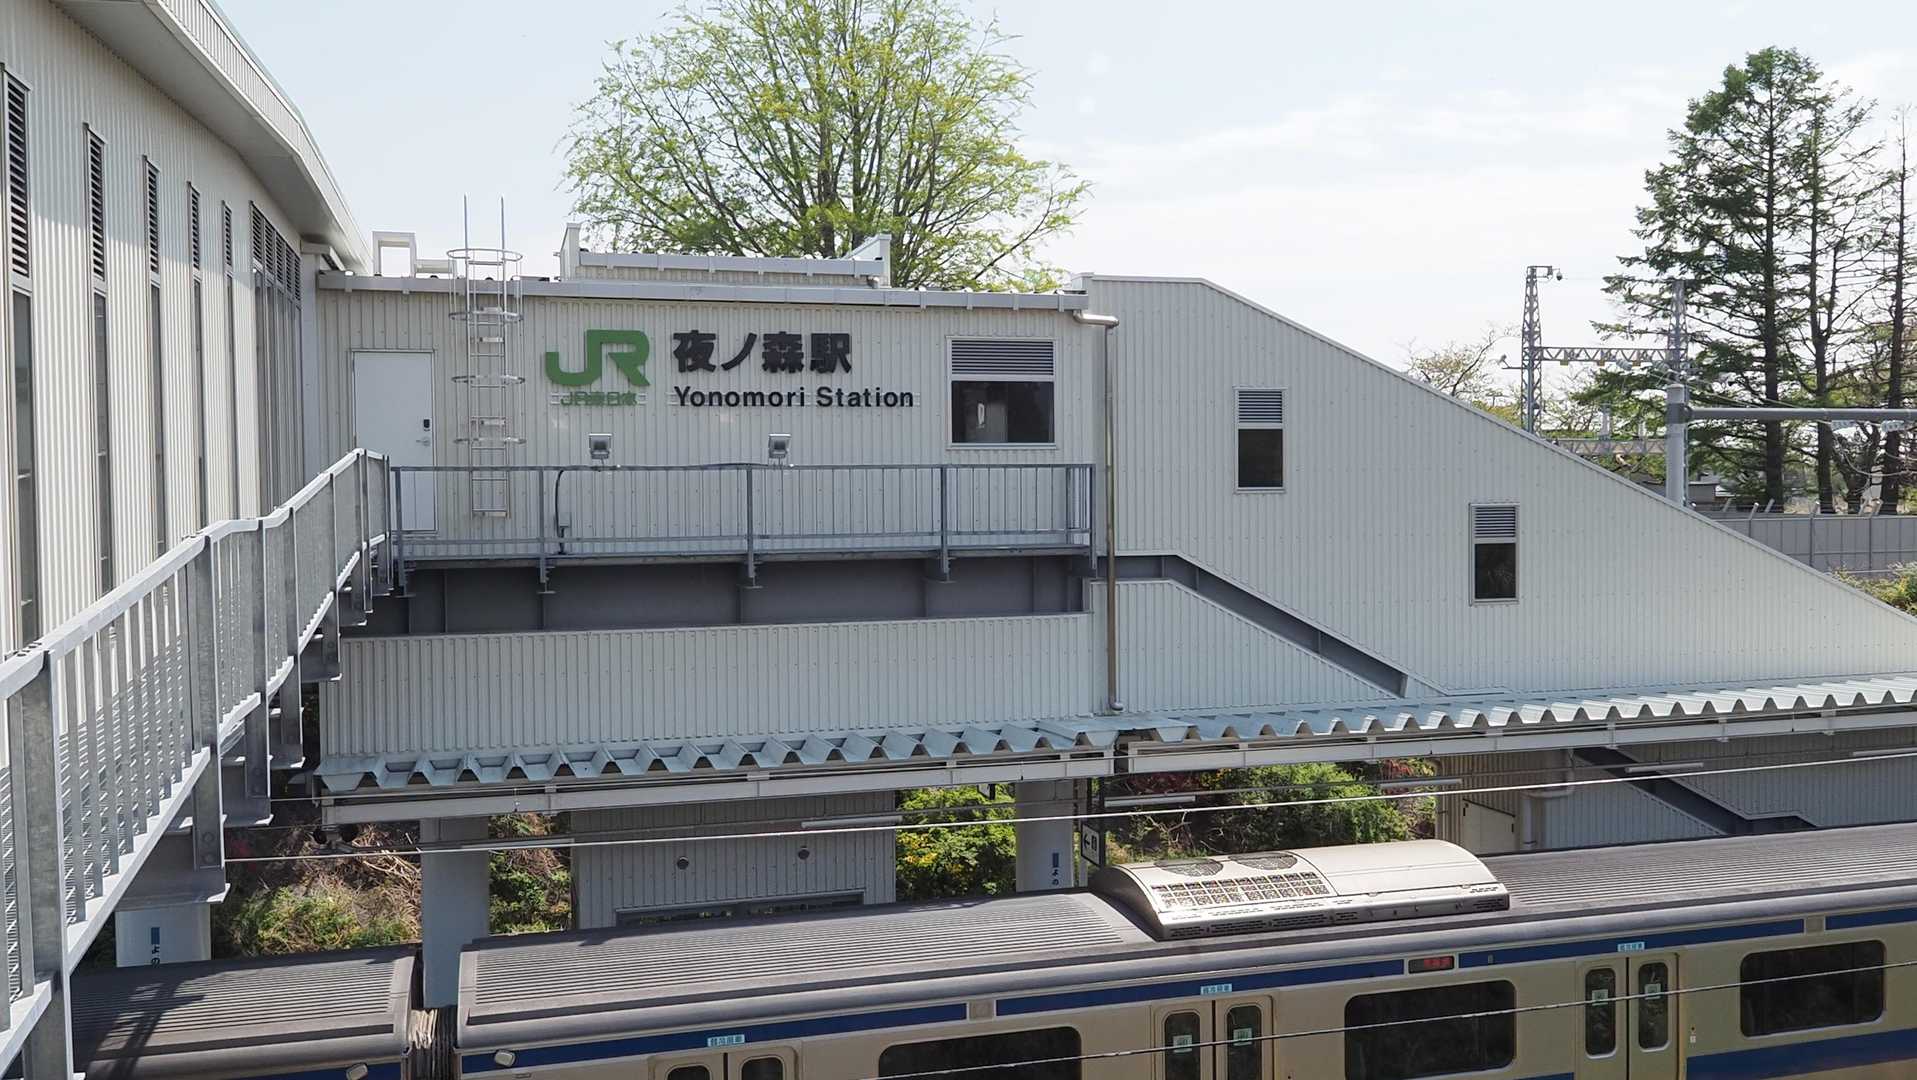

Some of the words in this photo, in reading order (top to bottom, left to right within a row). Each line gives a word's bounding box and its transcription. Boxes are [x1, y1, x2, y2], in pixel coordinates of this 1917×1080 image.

[545, 329, 651, 386] JR
[673, 330, 852, 373] 夜ノ森駅
[673, 386, 805, 407] Yonomori
[816, 386, 914, 407] Station
